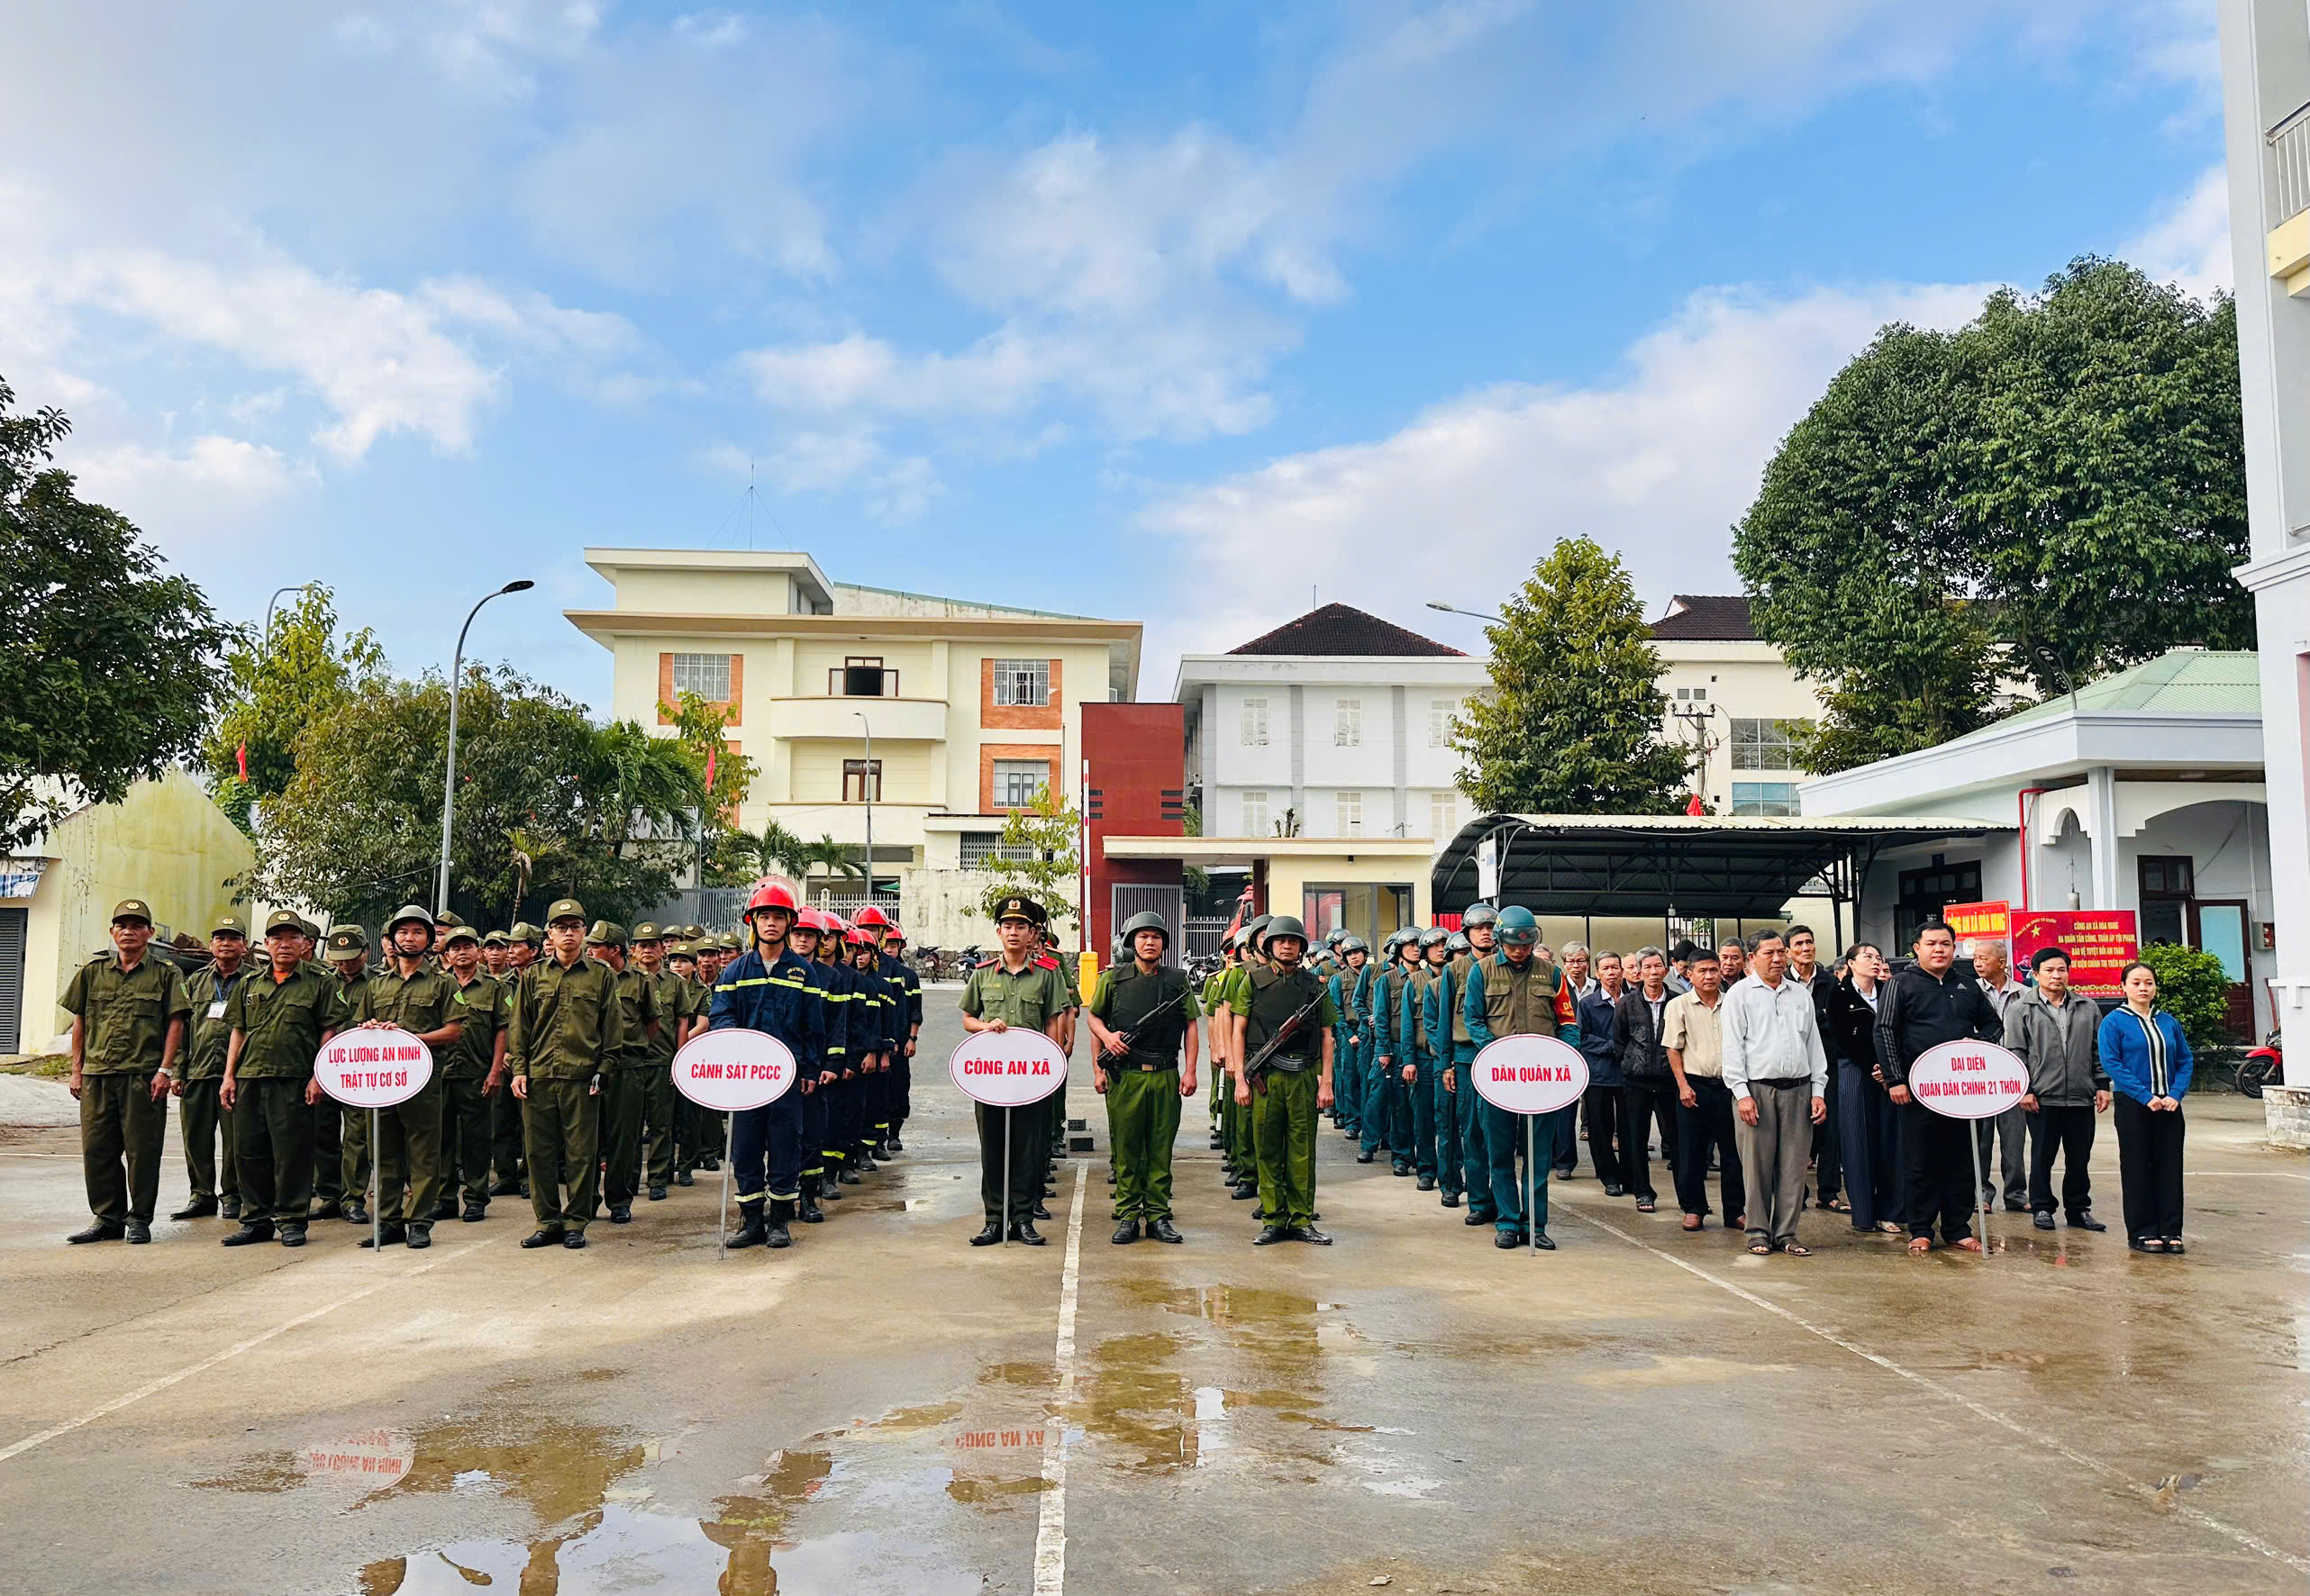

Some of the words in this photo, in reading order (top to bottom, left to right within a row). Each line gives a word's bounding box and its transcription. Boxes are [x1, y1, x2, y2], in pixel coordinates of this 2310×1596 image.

[329, 1047, 346, 1066] LỰC
[349, 1047, 379, 1066] LƯỢNG
[382, 1047, 396, 1062] AN
[397, 1046, 421, 1061] NINH
[964, 1057, 1003, 1075] CÔNG
[1007, 1060, 1027, 1075] AN
[1032, 1058, 1050, 1075] XÃ
[1951, 1056, 1965, 1075] ĐẠI
[1967, 1053, 1987, 1075] DIỆN
[341, 1070, 363, 1092] TRẬT
[365, 1071, 378, 1091] TỰ
[379, 1071, 393, 1087] CƠ
[395, 1067, 408, 1087] SỞ
[691, 1059, 723, 1079] CẢNH
[726, 1061, 748, 1080] SÁT
[750, 1065, 781, 1080] PCCC
[1491, 1064, 1516, 1082] DÂN
[1519, 1064, 1552, 1084] QUÂN
[1555, 1064, 1572, 1082] XÃ
[1919, 1079, 1942, 1098] QUÂN
[1942, 1079, 1960, 1096] DÂN
[1961, 1078, 1987, 1096] CHÍNH
[1987, 1080, 1997, 1095] 21
[2000, 1076, 2022, 1094] THÔN
